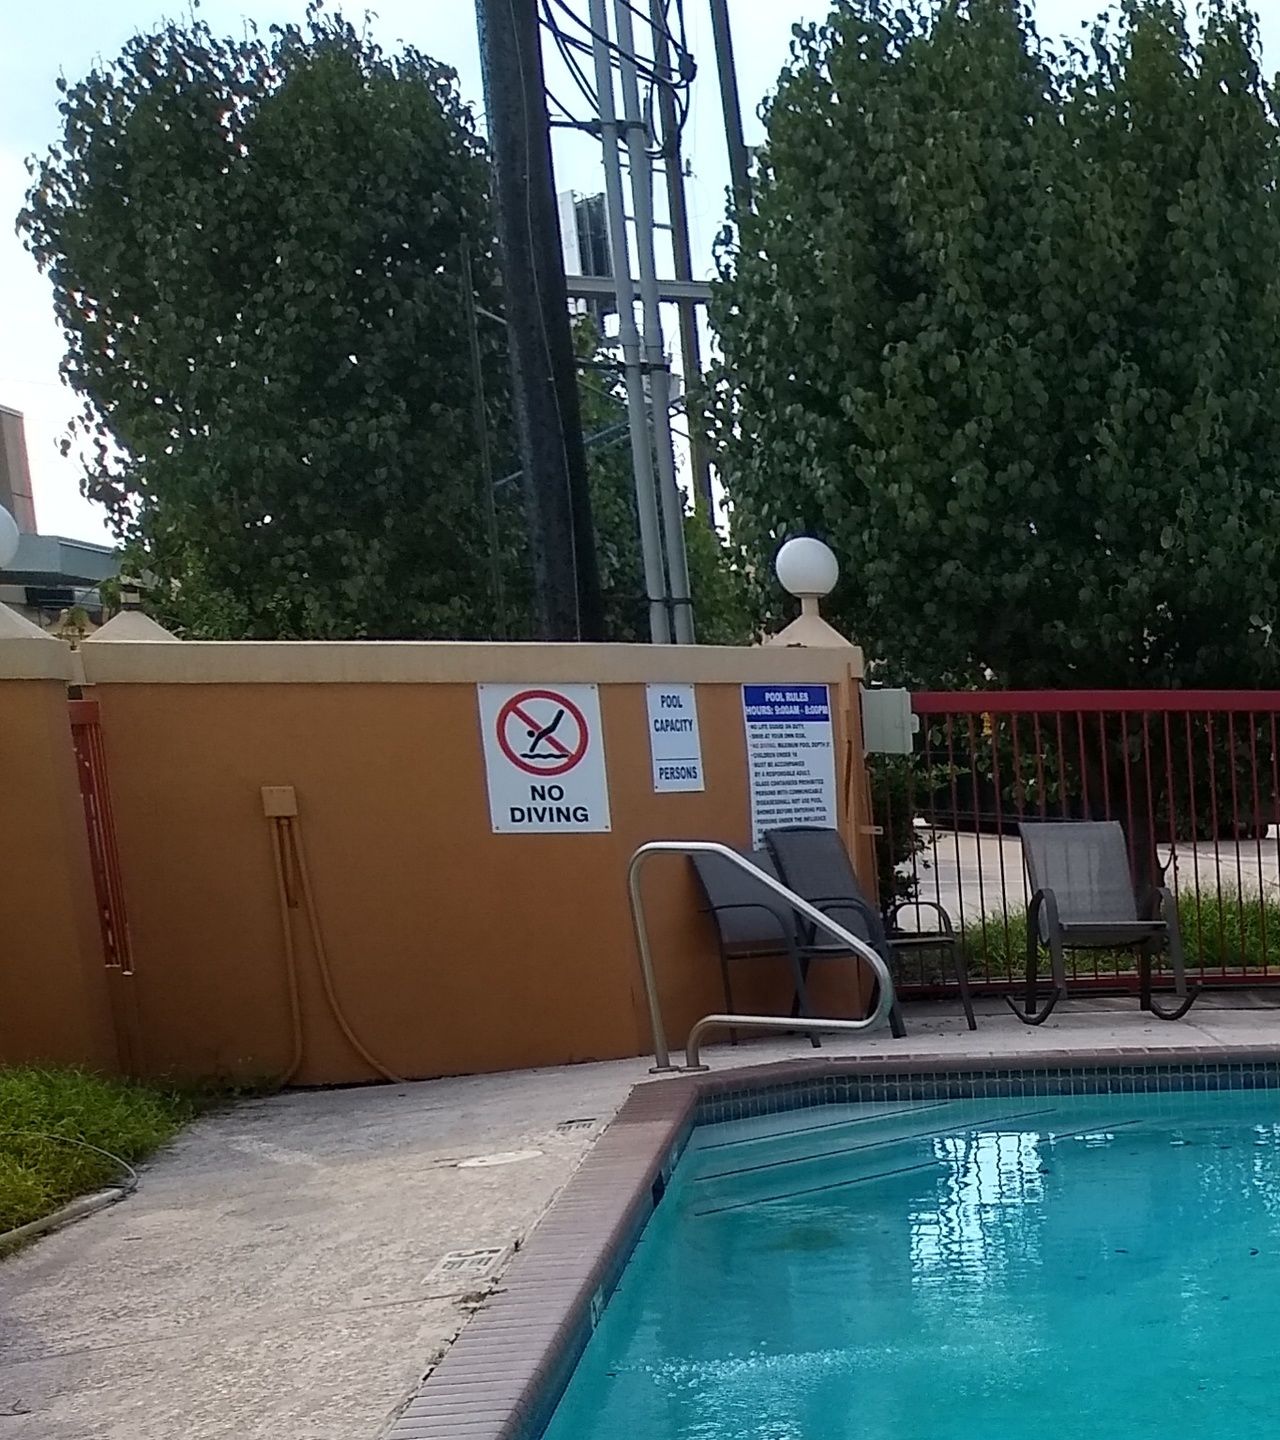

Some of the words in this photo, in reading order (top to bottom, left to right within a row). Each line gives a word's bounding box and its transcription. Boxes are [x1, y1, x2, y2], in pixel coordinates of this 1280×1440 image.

[660, 695, 683, 708] POOL
[765, 692, 785, 702] POOL
[785, 692, 809, 702] RULES
[654, 719, 693, 732] CAPACITY
[659, 766, 698, 780] PERSONS
[530, 785, 564, 801] NO
[510, 807, 590, 823] DIVING
